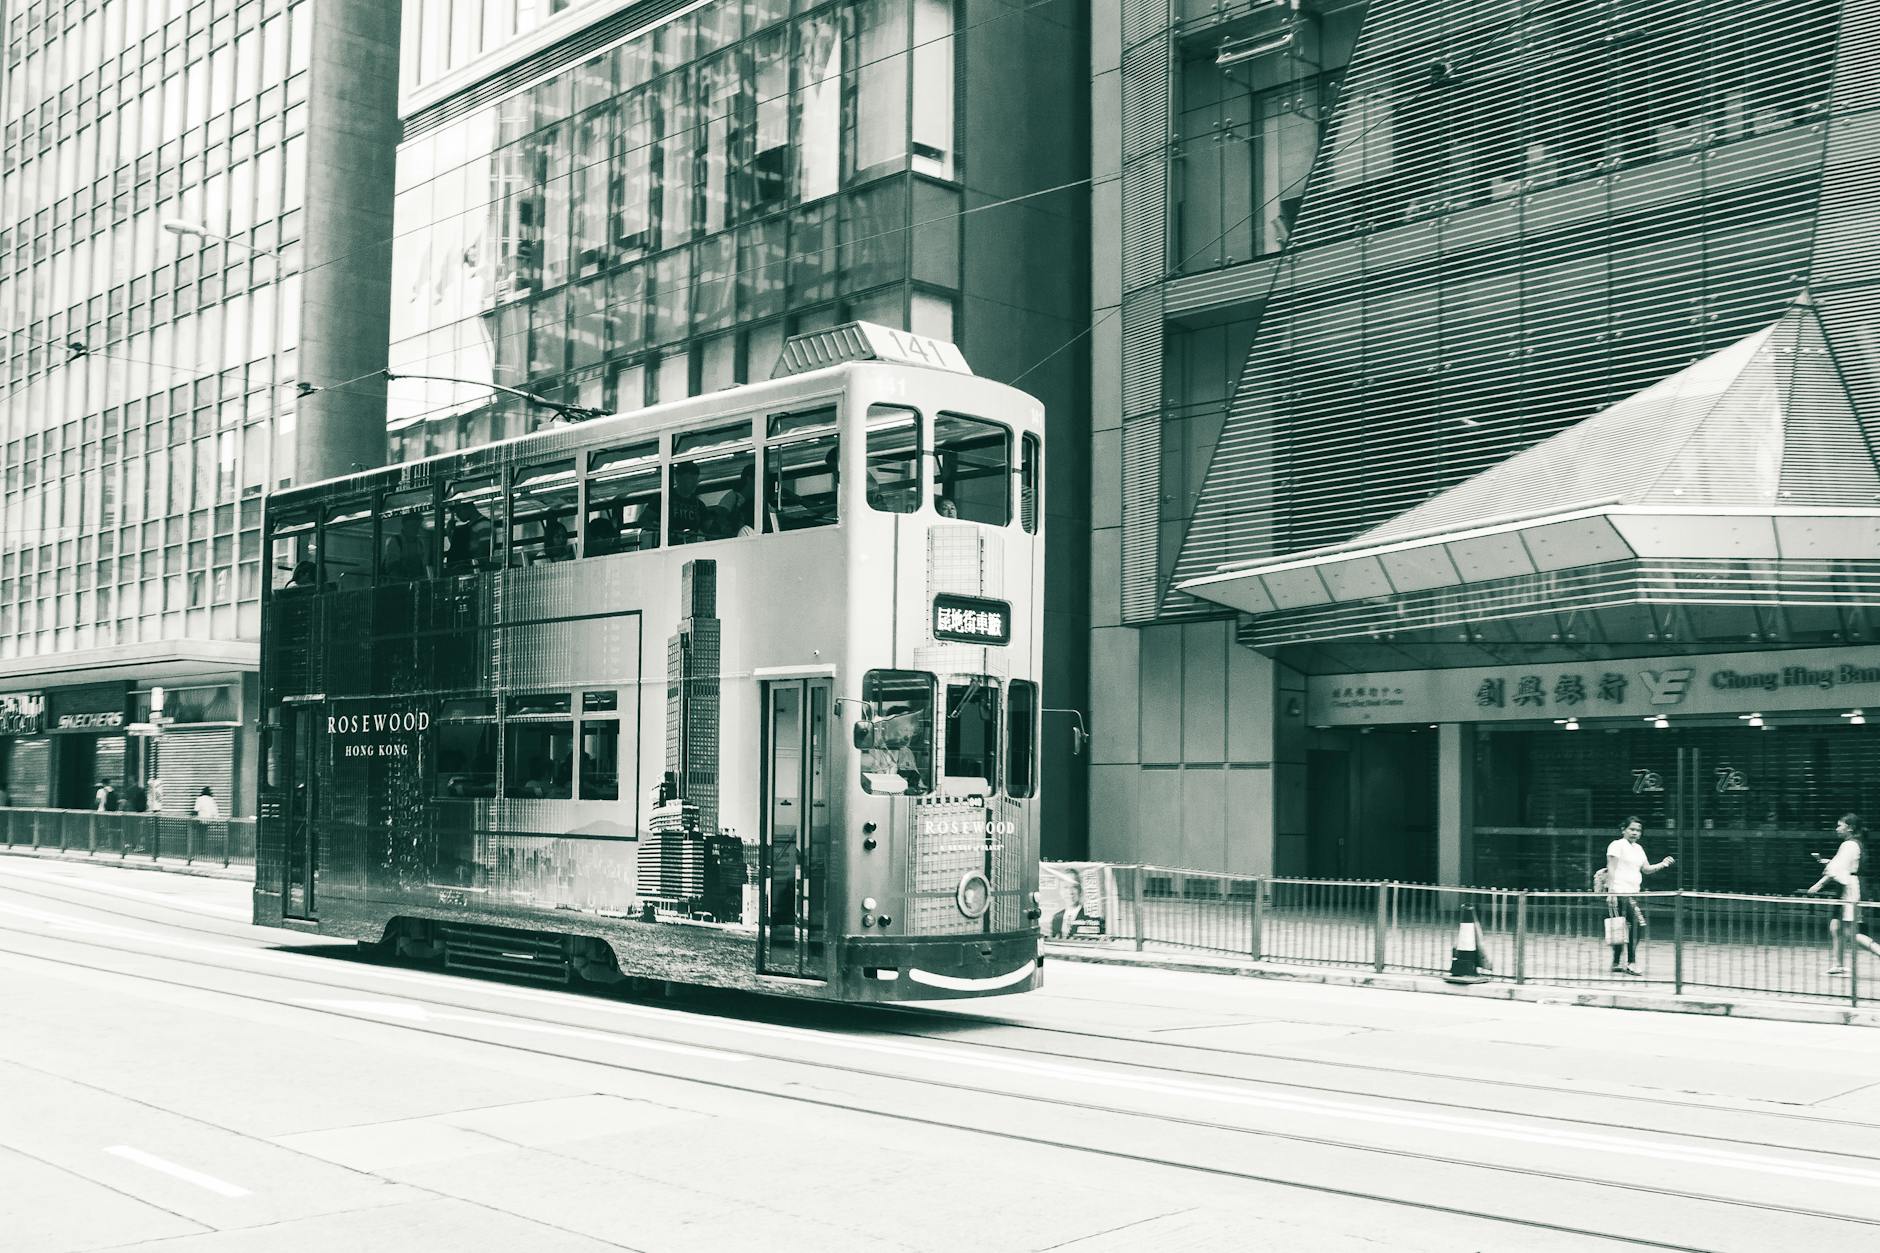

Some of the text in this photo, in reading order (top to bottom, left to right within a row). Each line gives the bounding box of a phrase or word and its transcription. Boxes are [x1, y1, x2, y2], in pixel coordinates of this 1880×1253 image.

[889, 330, 947, 367] 141
[57, 711, 124, 729] SKECHERS
[327, 712, 429, 734] ROSEWOOD
[345, 744, 408, 757] HONG KONG
[925, 820, 1015, 835] ROSEWOOD
